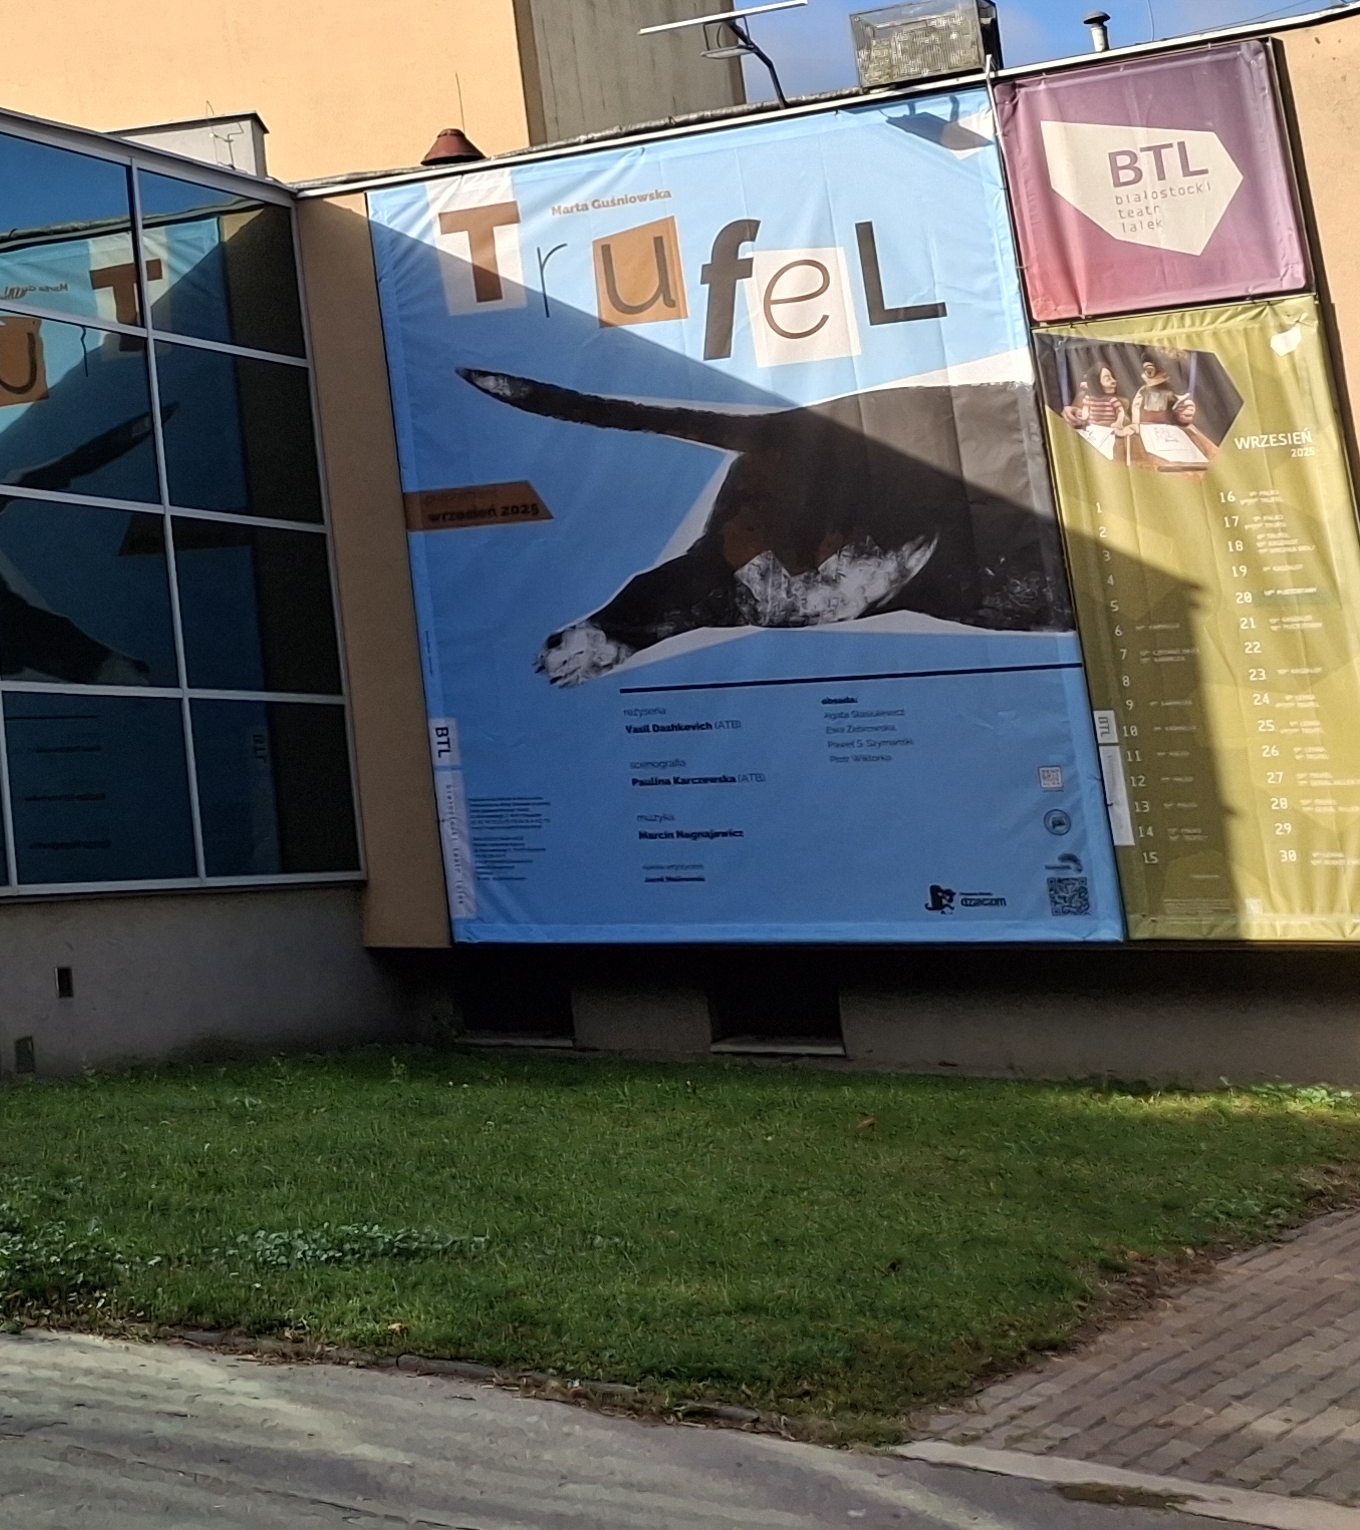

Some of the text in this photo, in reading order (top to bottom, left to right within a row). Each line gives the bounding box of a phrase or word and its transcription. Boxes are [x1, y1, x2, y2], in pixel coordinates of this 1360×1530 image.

[1108, 141, 1209, 189] BTL
[551, 188, 673, 217] Marta Guśniowska
[1118, 204, 1161, 220] teatr
[1121, 219, 1164, 234] lalek
[1234, 427, 1313, 450] WRZESIEŃ
[1290, 447, 1316, 458] 2025
[1220, 490, 1236, 503] 16
[1096, 502, 1102, 513] 1
[1224, 516, 1240, 528] 17
[1099, 526, 1108, 537] 2
[1228, 540, 1244, 552] 18
[1103, 551, 1111, 562] 3
[1232, 565, 1247, 577] 19
[1107, 575, 1115, 586] 4
[1235, 592, 1252, 604] 20
[1110, 600, 1119, 612] 5
[1240, 617, 1256, 630] 21
[1114, 625, 1122, 636] 6
[1244, 641, 1262, 654] 22
[1120, 649, 1127, 660] 7
[1122, 675, 1130, 687] 8
[1248, 669, 1266, 681] 23
[1126, 699, 1133, 710] 9
[1252, 693, 1270, 706] 24
[652, 721, 713, 733] Dashkevich
[1123, 726, 1138, 737] 10
[1257, 719, 1275, 732] 25
[435, 726, 451, 758] BTL
[1127, 750, 1142, 762] 11
[1261, 745, 1280, 758] 26
[632, 776, 671, 786] Paulina
[1130, 776, 1146, 787] 12
[1266, 772, 1284, 784] 27
[1134, 801, 1150, 813] 13
[1271, 798, 1288, 810] 28
[1138, 826, 1154, 838] 14
[1274, 823, 1292, 835] 29
[1143, 852, 1159, 864] 15
[1279, 850, 1297, 862] 30
